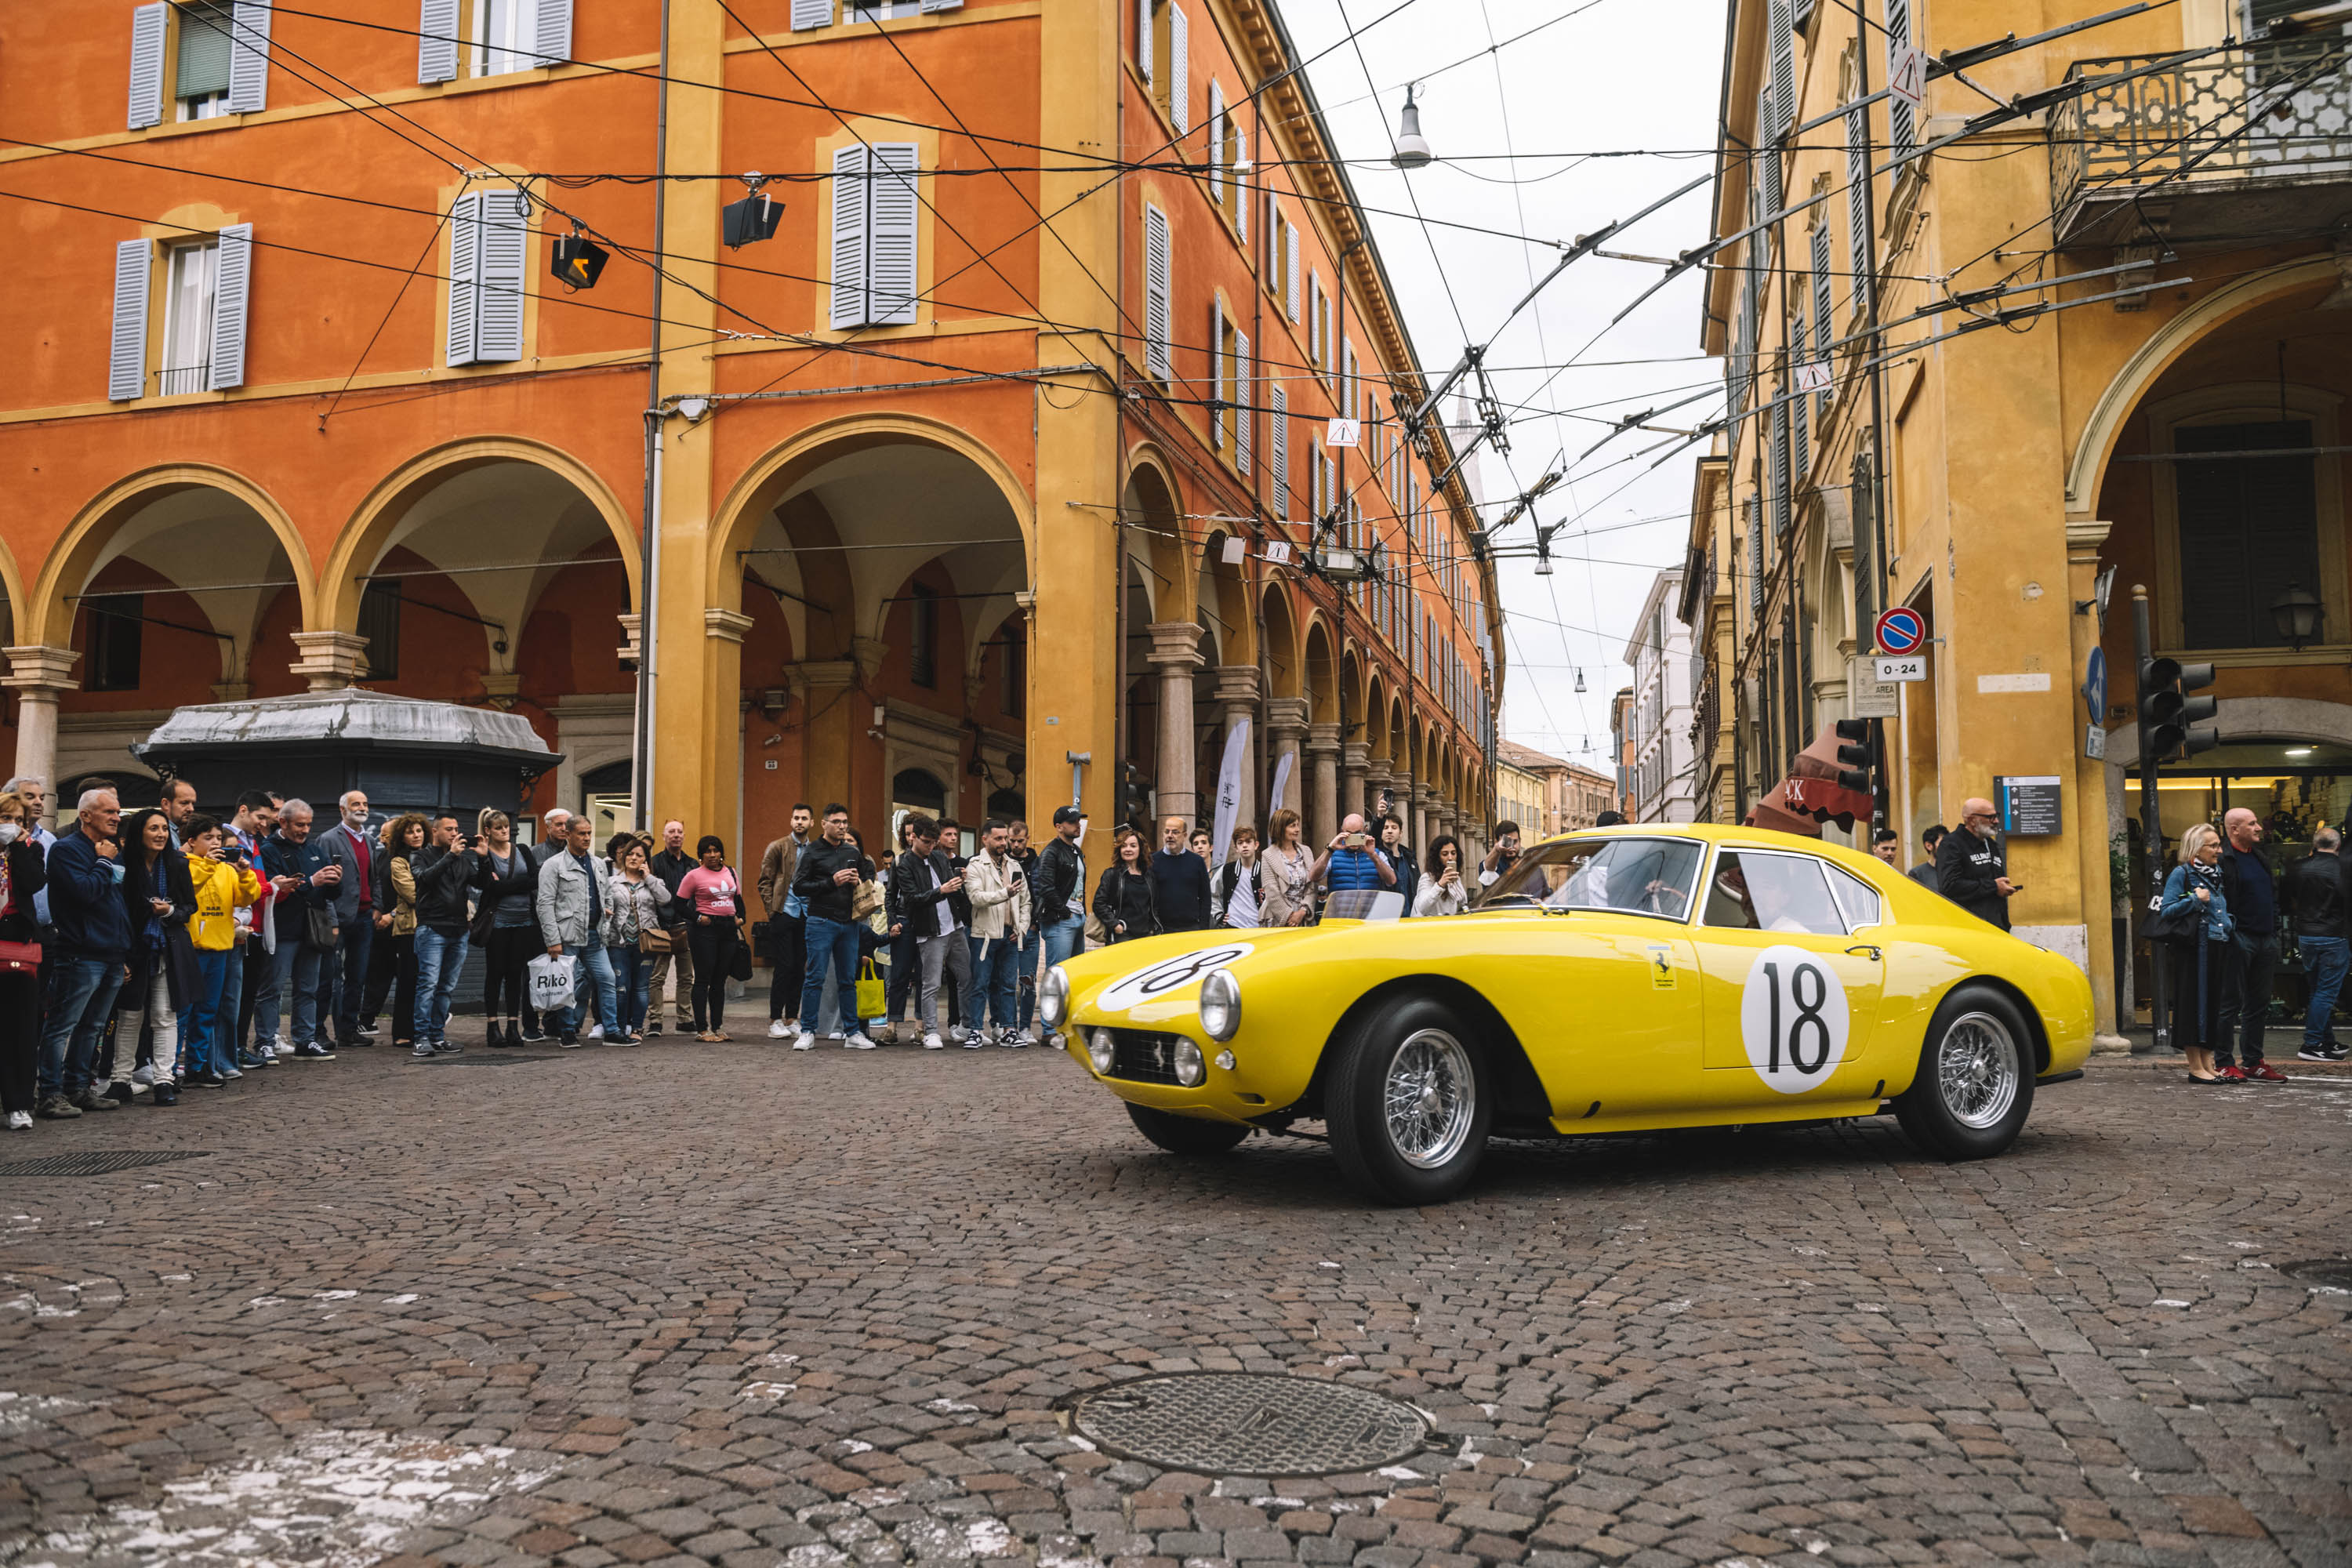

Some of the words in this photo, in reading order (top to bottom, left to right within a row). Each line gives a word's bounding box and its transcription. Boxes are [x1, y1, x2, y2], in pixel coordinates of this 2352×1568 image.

[1883, 665, 1893, 675] 0
[1900, 663, 1918, 674] 24
[1875, 685, 1895, 694] AREA
[1109, 950, 1243, 993] 18
[536, 973, 568, 989] Rikò
[1763, 962, 1830, 1074] 18
